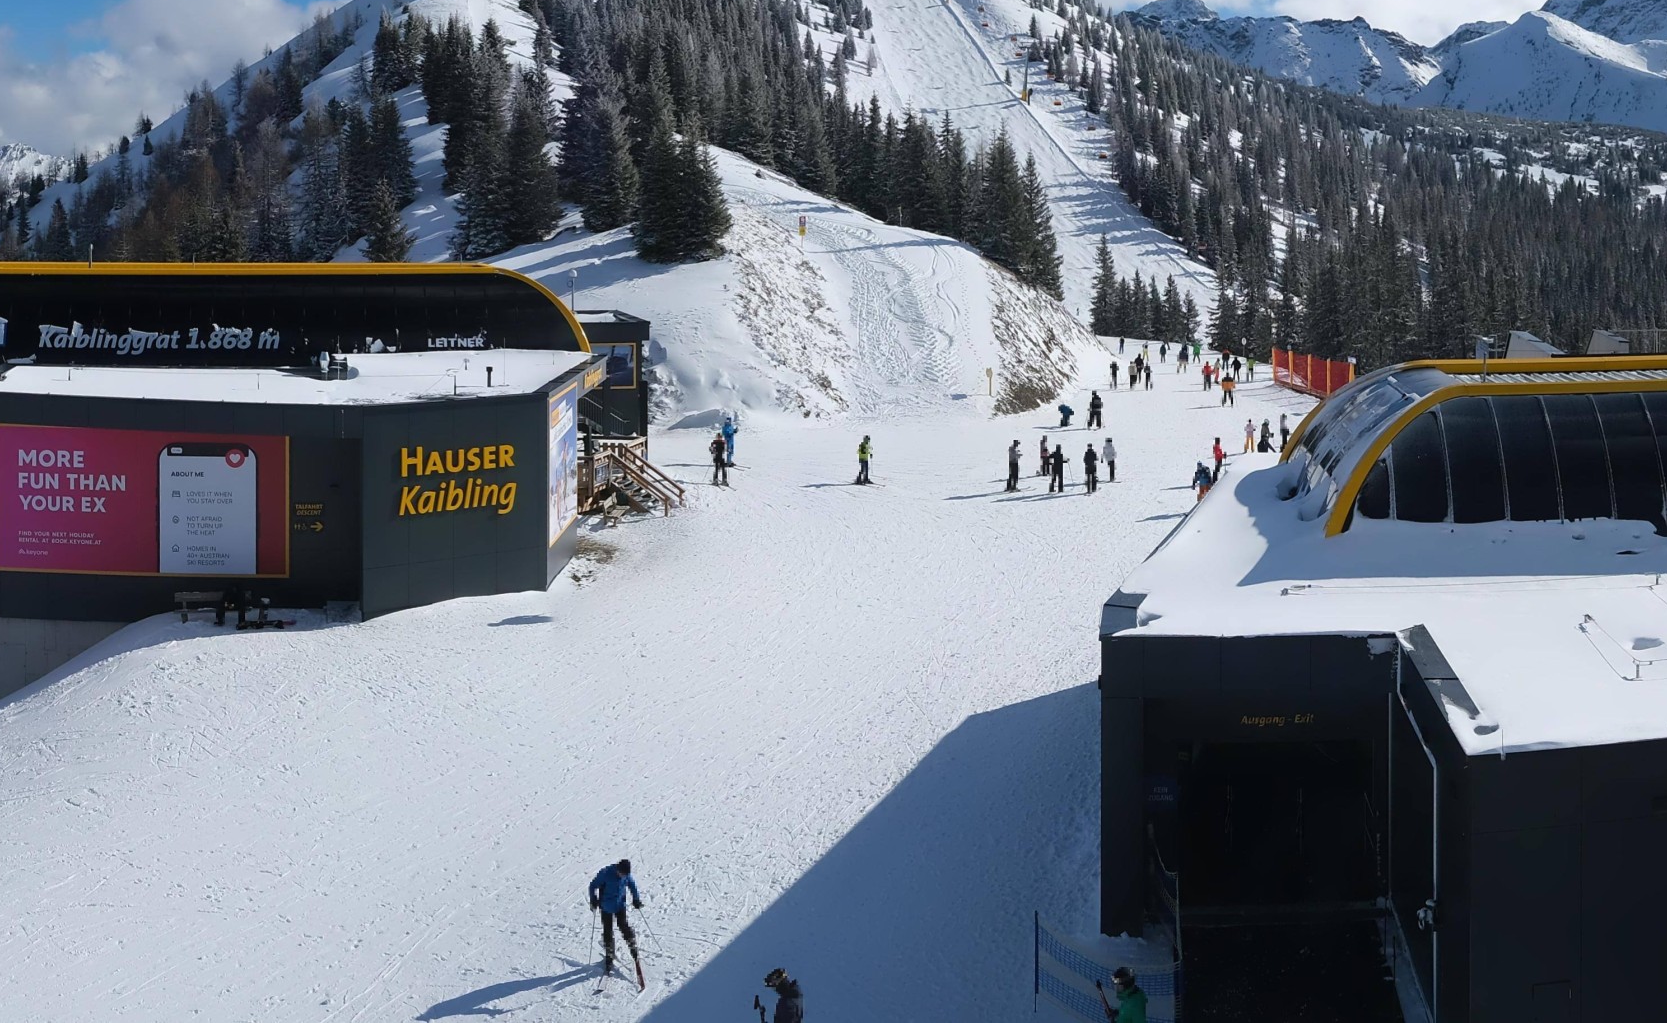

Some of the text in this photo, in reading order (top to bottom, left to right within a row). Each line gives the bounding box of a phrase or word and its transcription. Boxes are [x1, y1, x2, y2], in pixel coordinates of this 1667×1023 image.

[38, 327, 280, 355] Kaiblinggrat 1.868 m
[427, 337, 484, 348] LEITNER
[18, 449, 84, 468] MORE
[401, 444, 516, 478] HAUSER
[18, 472, 126, 492] FUN THAN
[19, 495, 106, 513] YOUR EX
[398, 478, 517, 516] Kaibling
[26, 548, 49, 557] keyone
[1240, 715, 1286, 726] Ausgang
[1295, 714, 1315, 724] Exit
